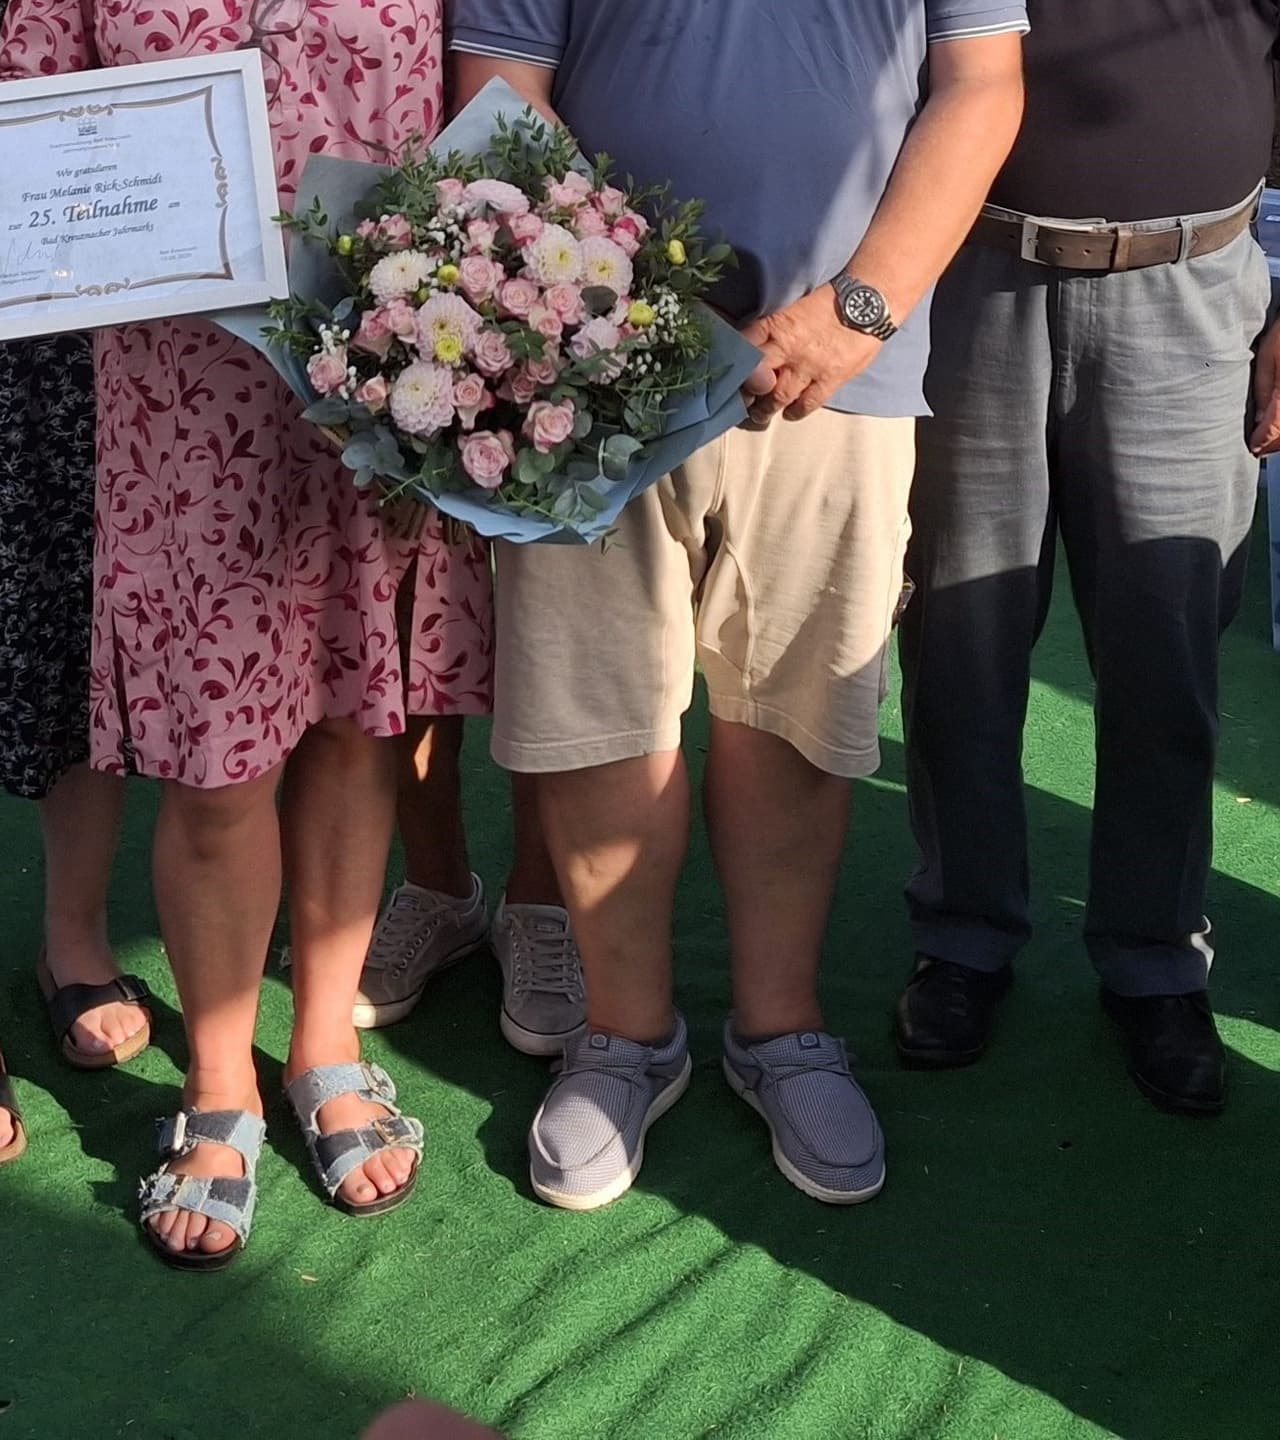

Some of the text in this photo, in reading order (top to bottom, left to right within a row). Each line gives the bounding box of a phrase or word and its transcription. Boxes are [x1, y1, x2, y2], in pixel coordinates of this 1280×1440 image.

[22, 191, 48, 202] Frau
[50, 184, 92, 200] Melanie
[29, 209, 56, 228] 25.
[63, 195, 158, 223] Teilnahme
